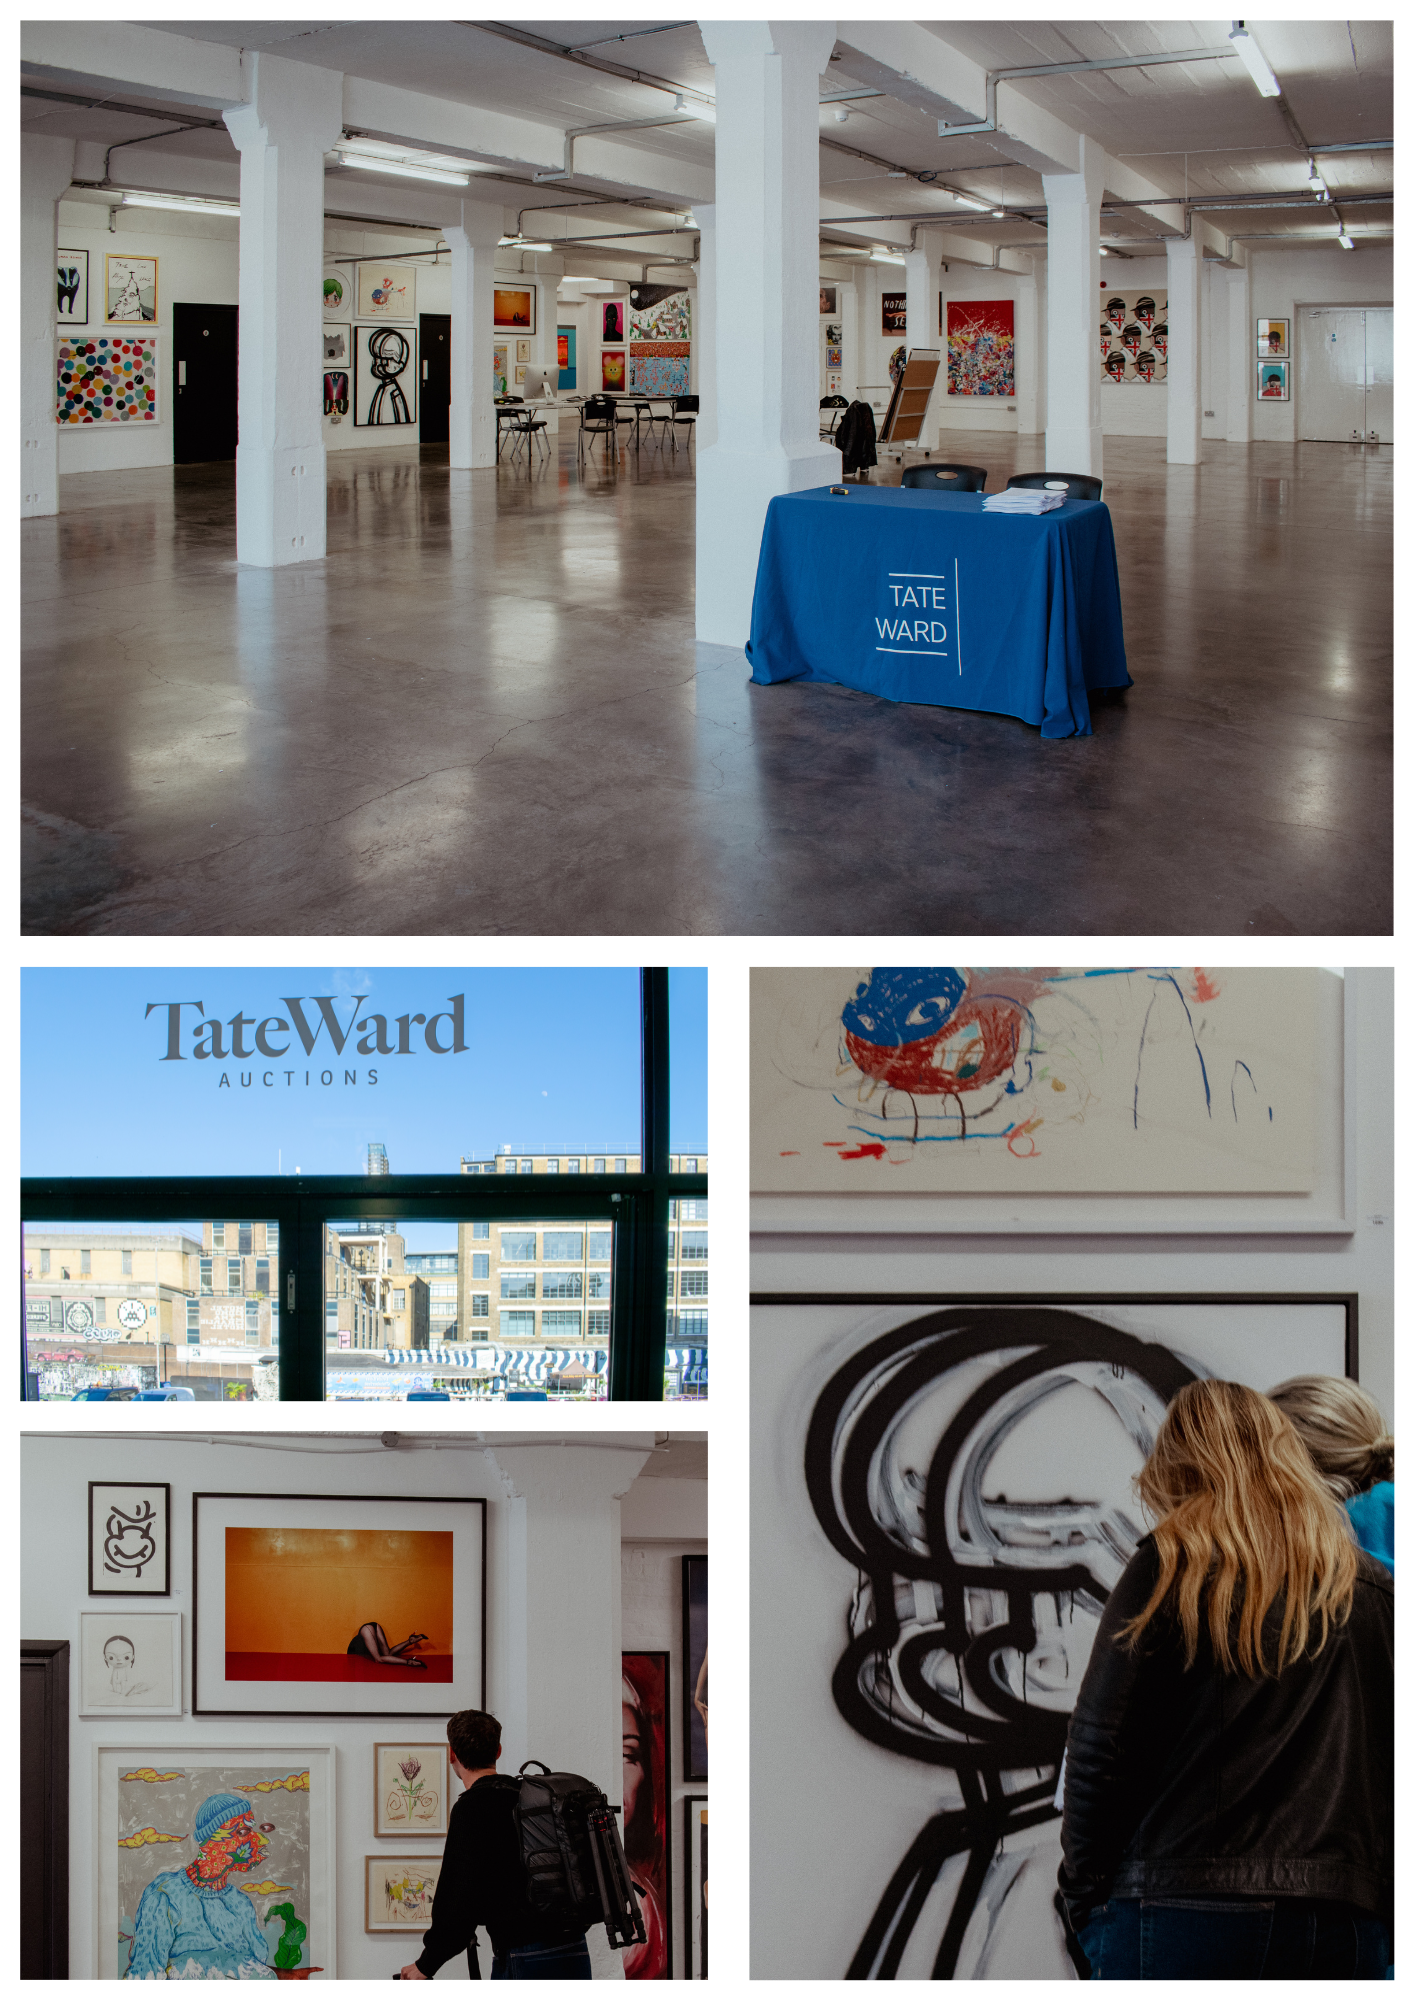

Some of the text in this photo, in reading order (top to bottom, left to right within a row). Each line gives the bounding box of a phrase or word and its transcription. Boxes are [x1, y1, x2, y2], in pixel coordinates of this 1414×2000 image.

[894, 316, 906, 327] SE
[889, 585, 946, 609] TATE
[875, 617, 947, 643] WARD
[144, 992, 470, 1061] TateWard
[218, 1069, 379, 1088] AUCTIONS
